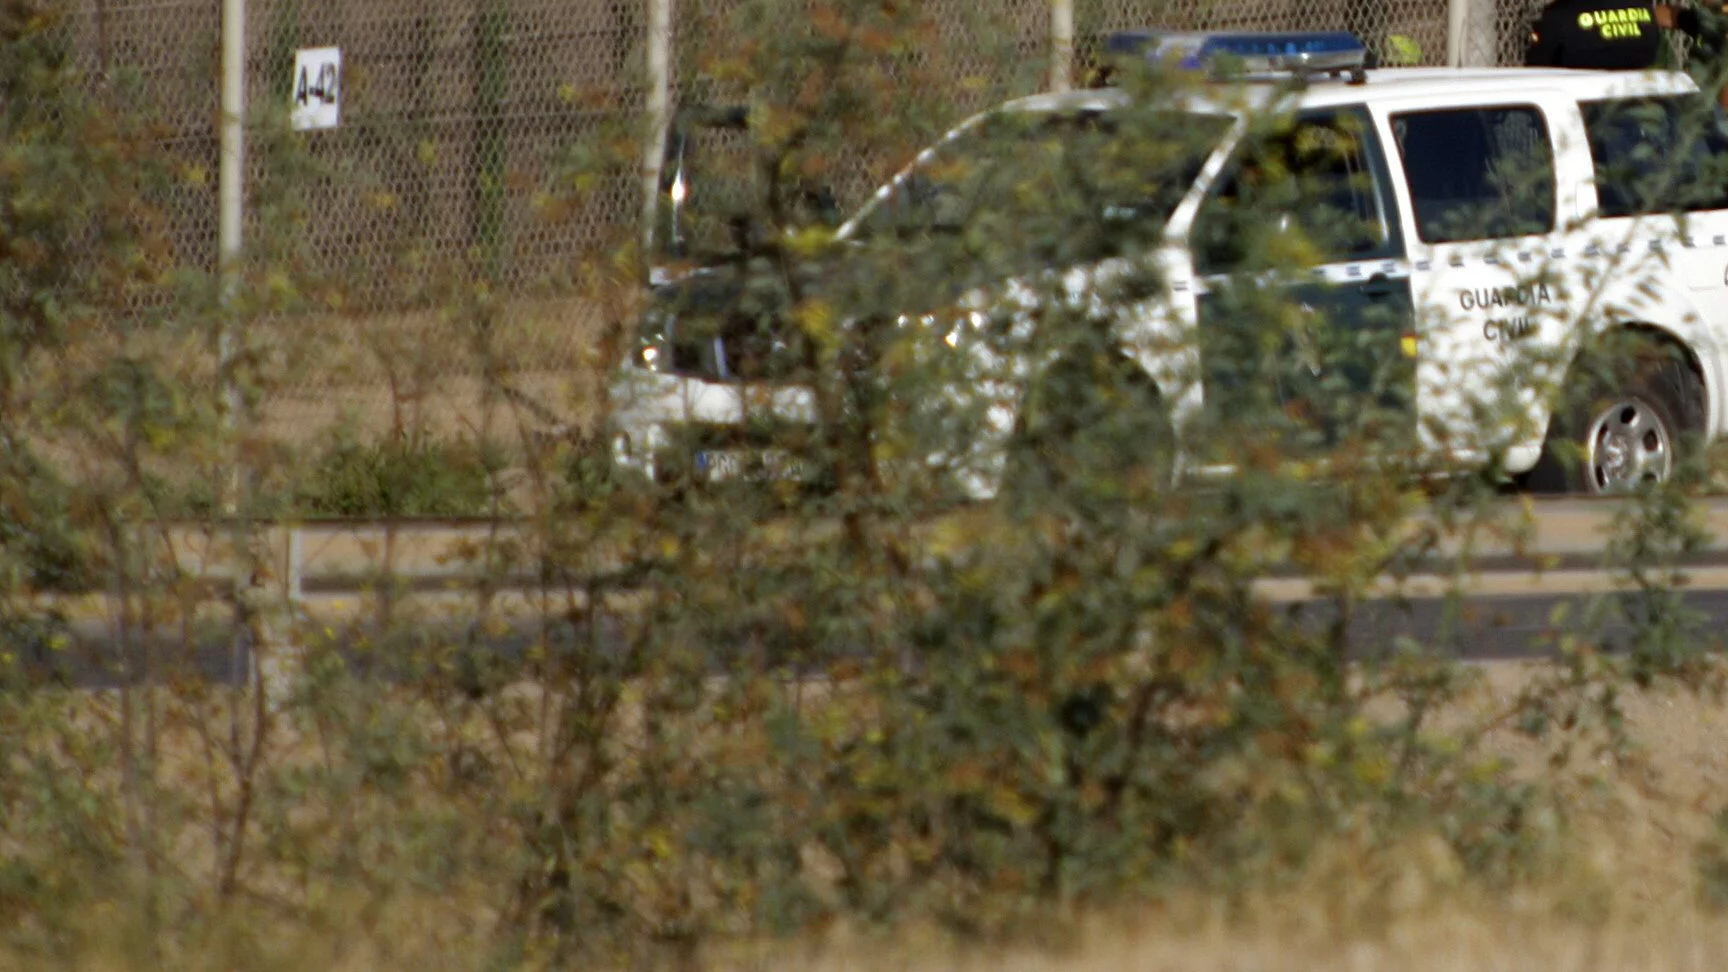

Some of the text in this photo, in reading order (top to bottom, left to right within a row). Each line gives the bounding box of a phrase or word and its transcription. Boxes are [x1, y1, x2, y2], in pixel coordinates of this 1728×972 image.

[1578, 8, 1651, 29] GUARDIA
[1601, 22, 1641, 40] CIVIL
[296, 62, 336, 106] A-42
[1460, 284, 1551, 310] GUADIA
